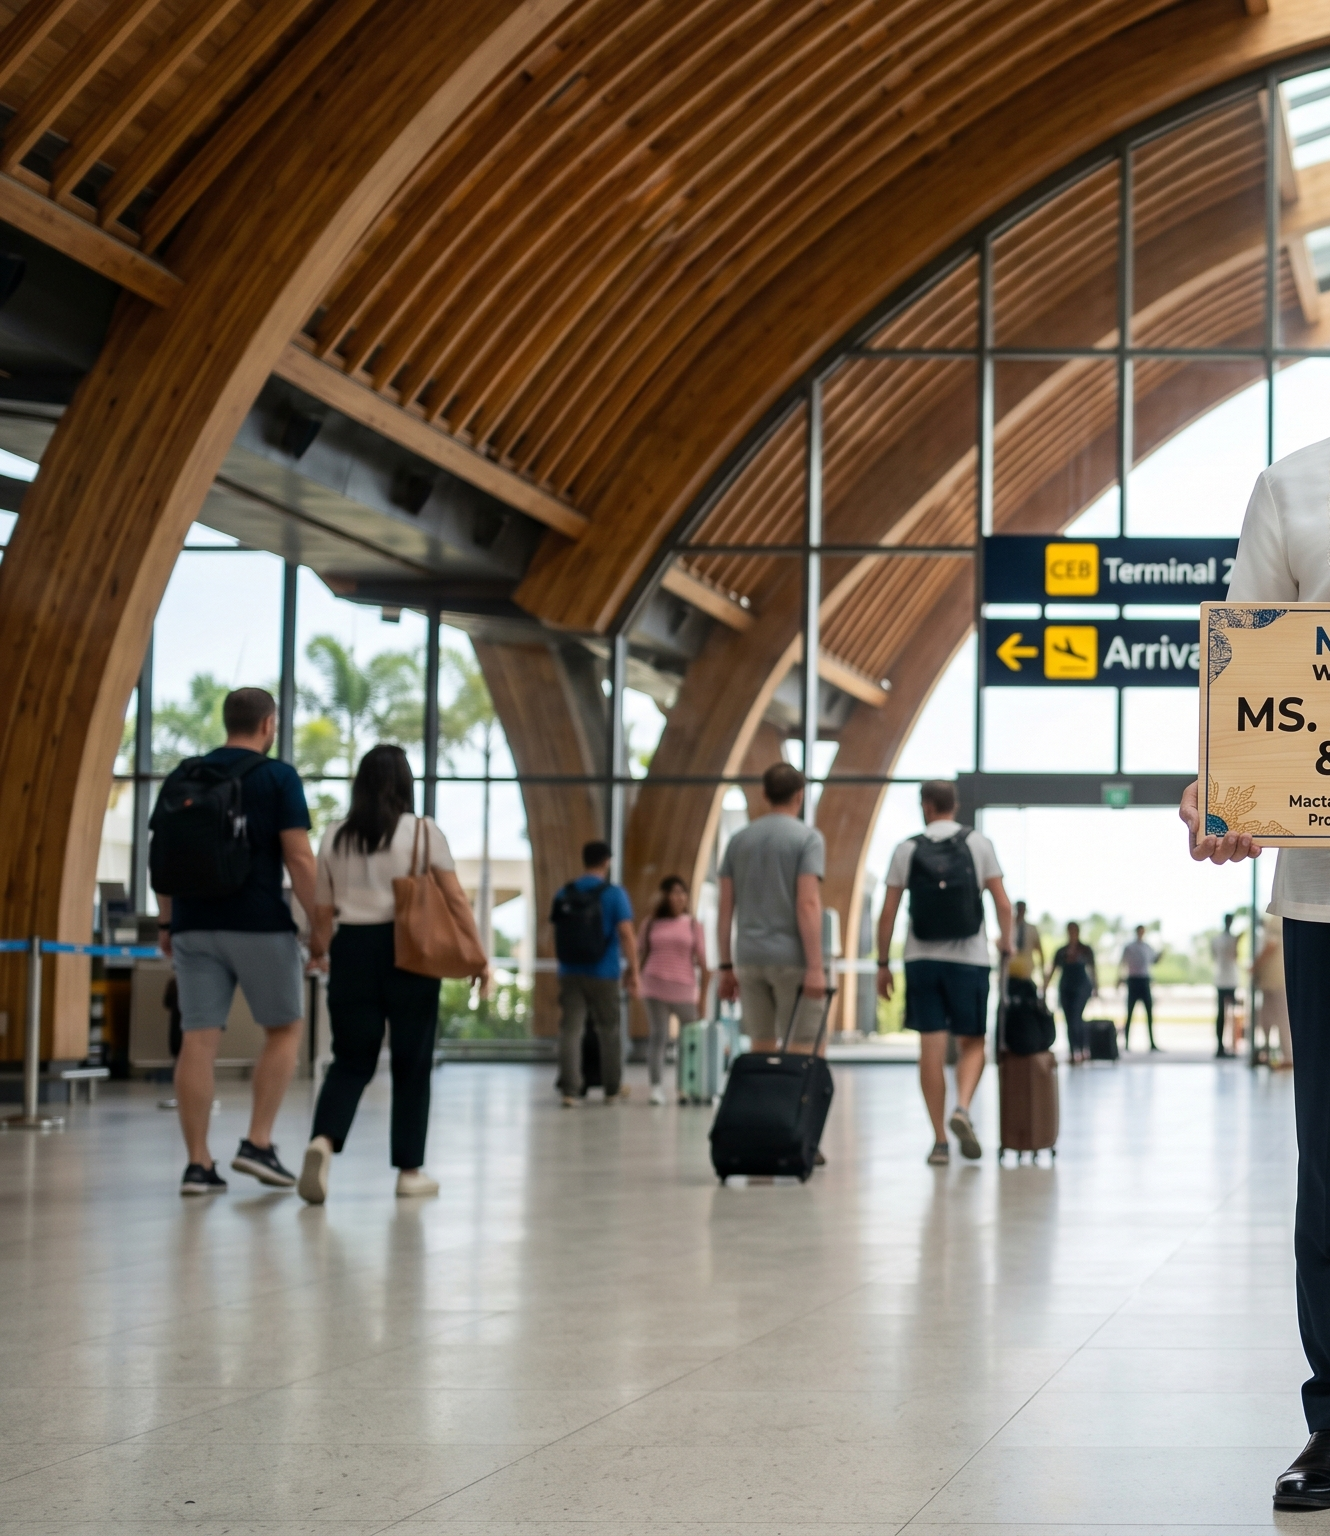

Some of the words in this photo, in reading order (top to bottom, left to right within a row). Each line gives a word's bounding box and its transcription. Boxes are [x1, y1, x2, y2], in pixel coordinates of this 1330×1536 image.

[1049, 559, 1092, 580] CEB
[1103, 557, 1216, 585] Terminal
[1237, 697, 1317, 733] MS.
